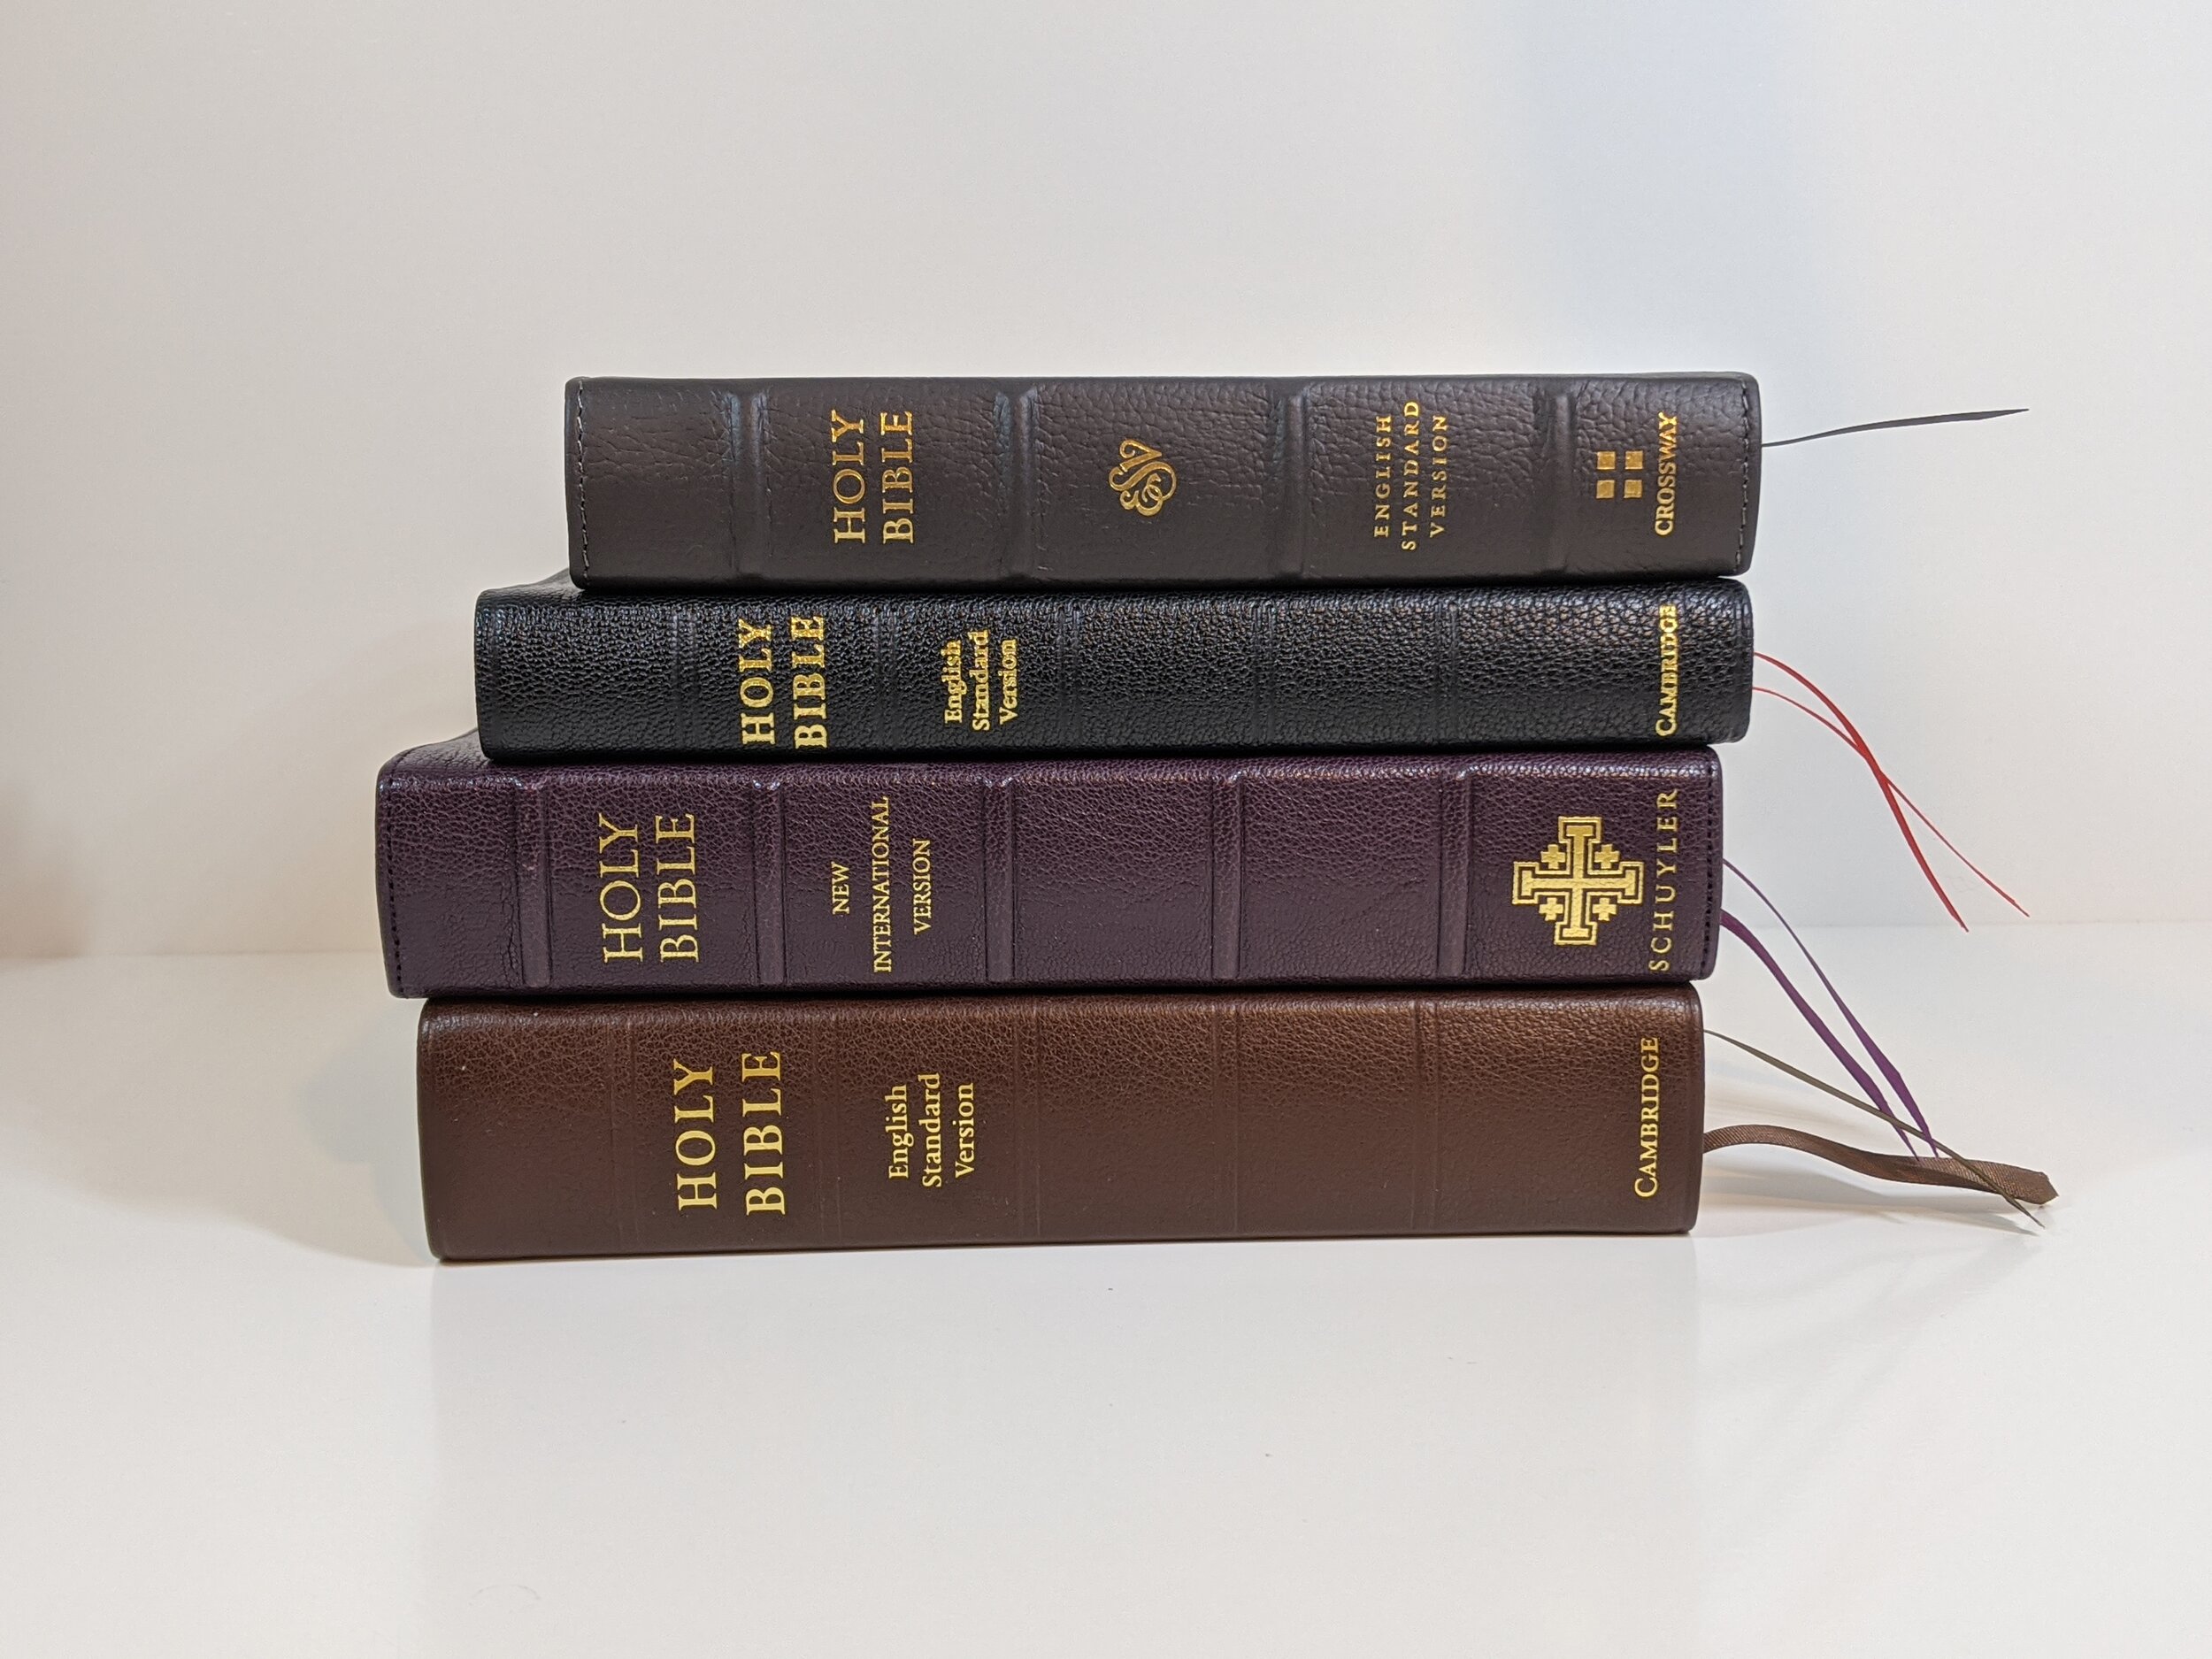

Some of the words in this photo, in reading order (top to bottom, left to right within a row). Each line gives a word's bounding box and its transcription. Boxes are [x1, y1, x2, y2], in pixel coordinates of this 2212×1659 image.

[830, 409, 866, 542] HOLY
[879, 411, 914, 542] BIBLE
[1373, 415, 1393, 538] ENGLISH
[1401, 401, 1422, 550] STANDARD
[1430, 415, 1449, 537] VERSION
[1655, 411, 1679, 536] CROSSWAY
[738, 618, 776, 744] HOLY
[790, 616, 828, 748] BIBLE
[941, 640, 967, 723] English
[968, 629, 991, 731] Standard
[998, 638, 1018, 724] Version
[1655, 603, 1679, 737] CAMBRIDGE
[598, 814, 643, 963] HOLY
[655, 814, 699, 960] BIBLE
[831, 863, 850, 915] NEW
[871, 795, 893, 973] INTERNATIONAL
[912, 839, 932, 935] VERSION
[1648, 787, 1679, 972] SCHUYLER
[672, 1057, 718, 1211] HOLY
[741, 1050, 786, 1217] BIBLE
[884, 1084, 914, 1179] English
[917, 1071, 942, 1188] Standard
[951, 1082, 975, 1179] Version
[1633, 1036, 1660, 1198] CAMBRIDGE
